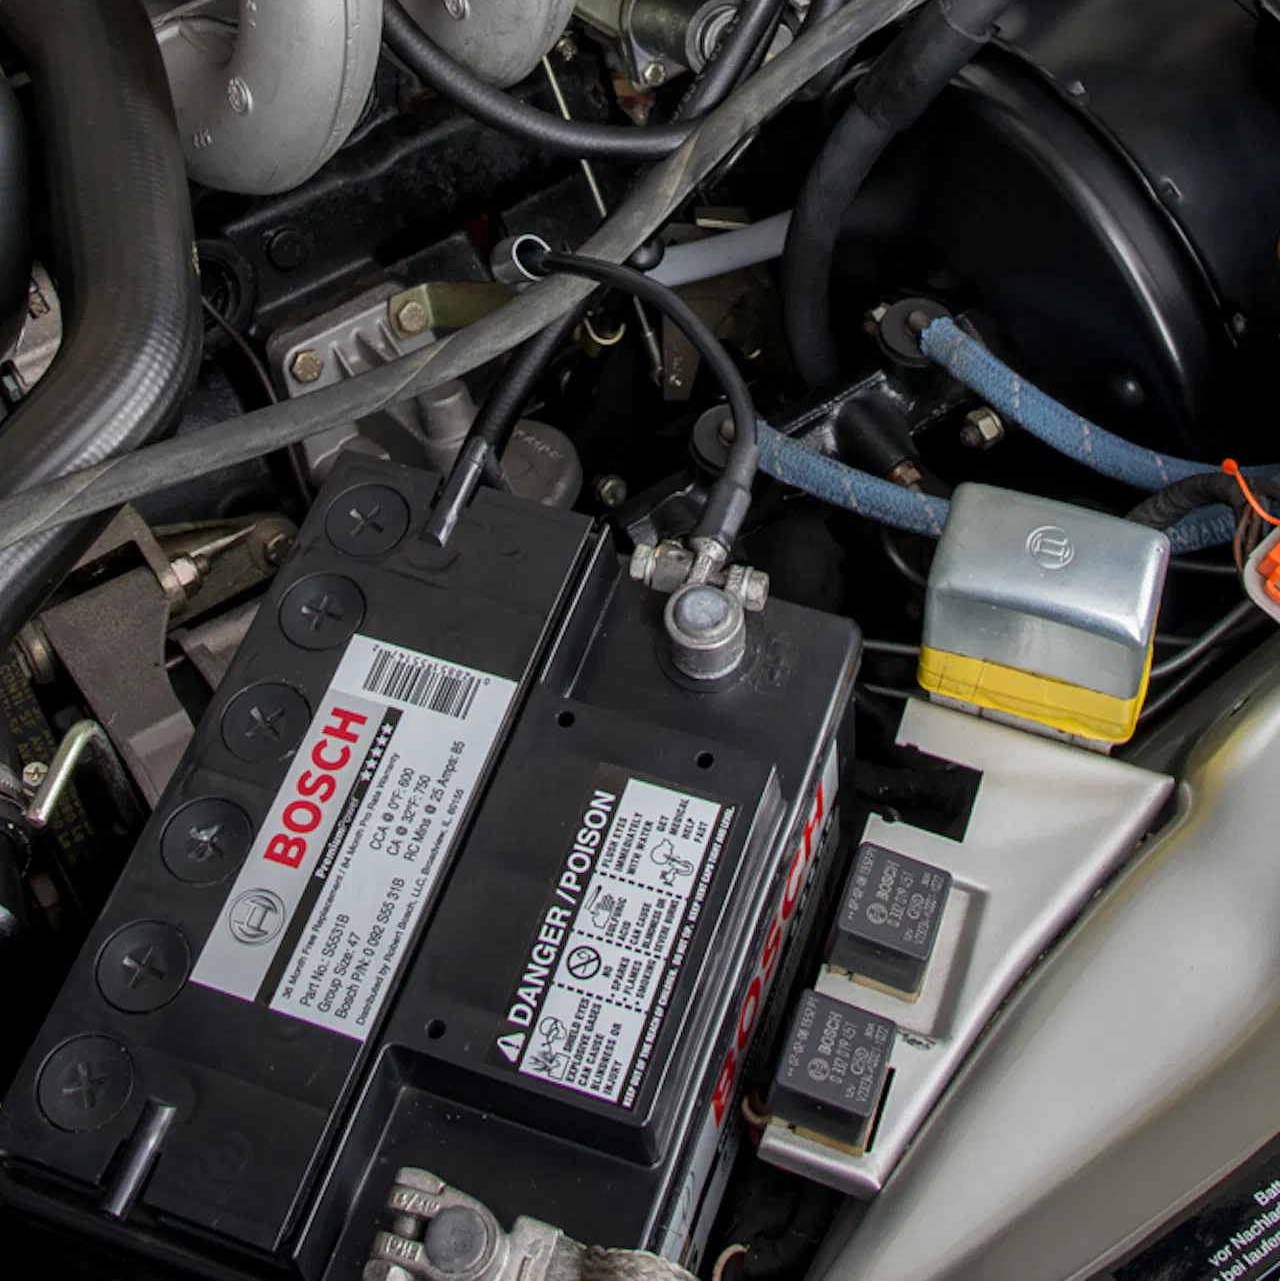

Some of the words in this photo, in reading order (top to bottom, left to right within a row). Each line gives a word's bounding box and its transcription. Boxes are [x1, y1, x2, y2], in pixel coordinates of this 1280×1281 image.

[450, 740, 466, 755] 85
[263, 707, 368, 869] BOSCH
[436, 754, 460, 788] Amps:
[368, 826, 390, 851] CCA
[397, 767, 415, 788] 600
[386, 839, 403, 856] CA
[412, 774, 432, 794] 750
[429, 787, 445, 803] 25
[411, 817, 432, 844] Mins
[656, 814, 669, 833] GET
[668, 798, 690, 836] MEDICAL
[681, 817, 695, 840] HELP
[693, 821, 708, 844] FAST
[402, 843, 420, 863] RC
[420, 829, 448, 876] Broadview,
[601, 840, 619, 869] FLUSH
[612, 816, 628, 840] EYES
[614, 811, 643, 873] IMMEDIATELY
[626, 852, 642, 876] WITH
[635, 820, 654, 851] WATER
[287, 956, 307, 986] Month
[301, 933, 318, 956] Free
[311, 874, 344, 933] Replacement
[346, 828, 365, 856] Month
[359, 811, 373, 828] Pro
[366, 790, 383, 811] Rata
[376, 752, 401, 789] Warranty
[411, 877, 428, 898] LLC,
[875, 859, 900, 902] BOSCH
[396, 900, 418, 931] Bosch,
[604, 896, 627, 938] SULFURIC
[617, 920, 632, 942] ACID
[635, 902, 652, 928] CAUSE
[641, 910, 663, 950] BLINDNESS
[653, 925, 671, 953] SEVERE
[663, 899, 679, 925] BURNS
[334, 983, 360, 1020] Bosch
[350, 957, 372, 983] P/N:
[376, 900, 395, 925] S55
[386, 877, 405, 901] 31B
[382, 930, 404, 963] Robert
[629, 928, 642, 946] CAN
[713, 782, 824, 1125] BOSCH
[298, 982, 320, 1008] Part
[321, 913, 350, 958] S5531B
[316, 977, 344, 1013] Group
[332, 948, 355, 977] Size:
[346, 931, 361, 948] 47
[377, 963, 391, 977] by
[507, 906, 572, 1027] DANGER
[610, 956, 631, 992] SPARKS
[622, 960, 643, 996] FLAMES
[635, 958, 657, 999] SMOKING
[355, 975, 384, 1027] Distributed
[562, 1021, 581, 1053] SHIELD
[574, 997, 591, 1021] EYES
[565, 1033, 591, 1083] EXPLOSIVE
[584, 1002, 602, 1033] GASES
[817, 1011, 843, 1056] BOSCH
[577, 1066, 592, 1087] CAN
[585, 1033, 605, 1065] CAUSE
[589, 1038, 617, 1092] BLINDNESS
[602, 1059, 623, 1096] INJURY
[1208, 1244, 1233, 1267] vor
[1219, 1259, 1247, 1281] bei
